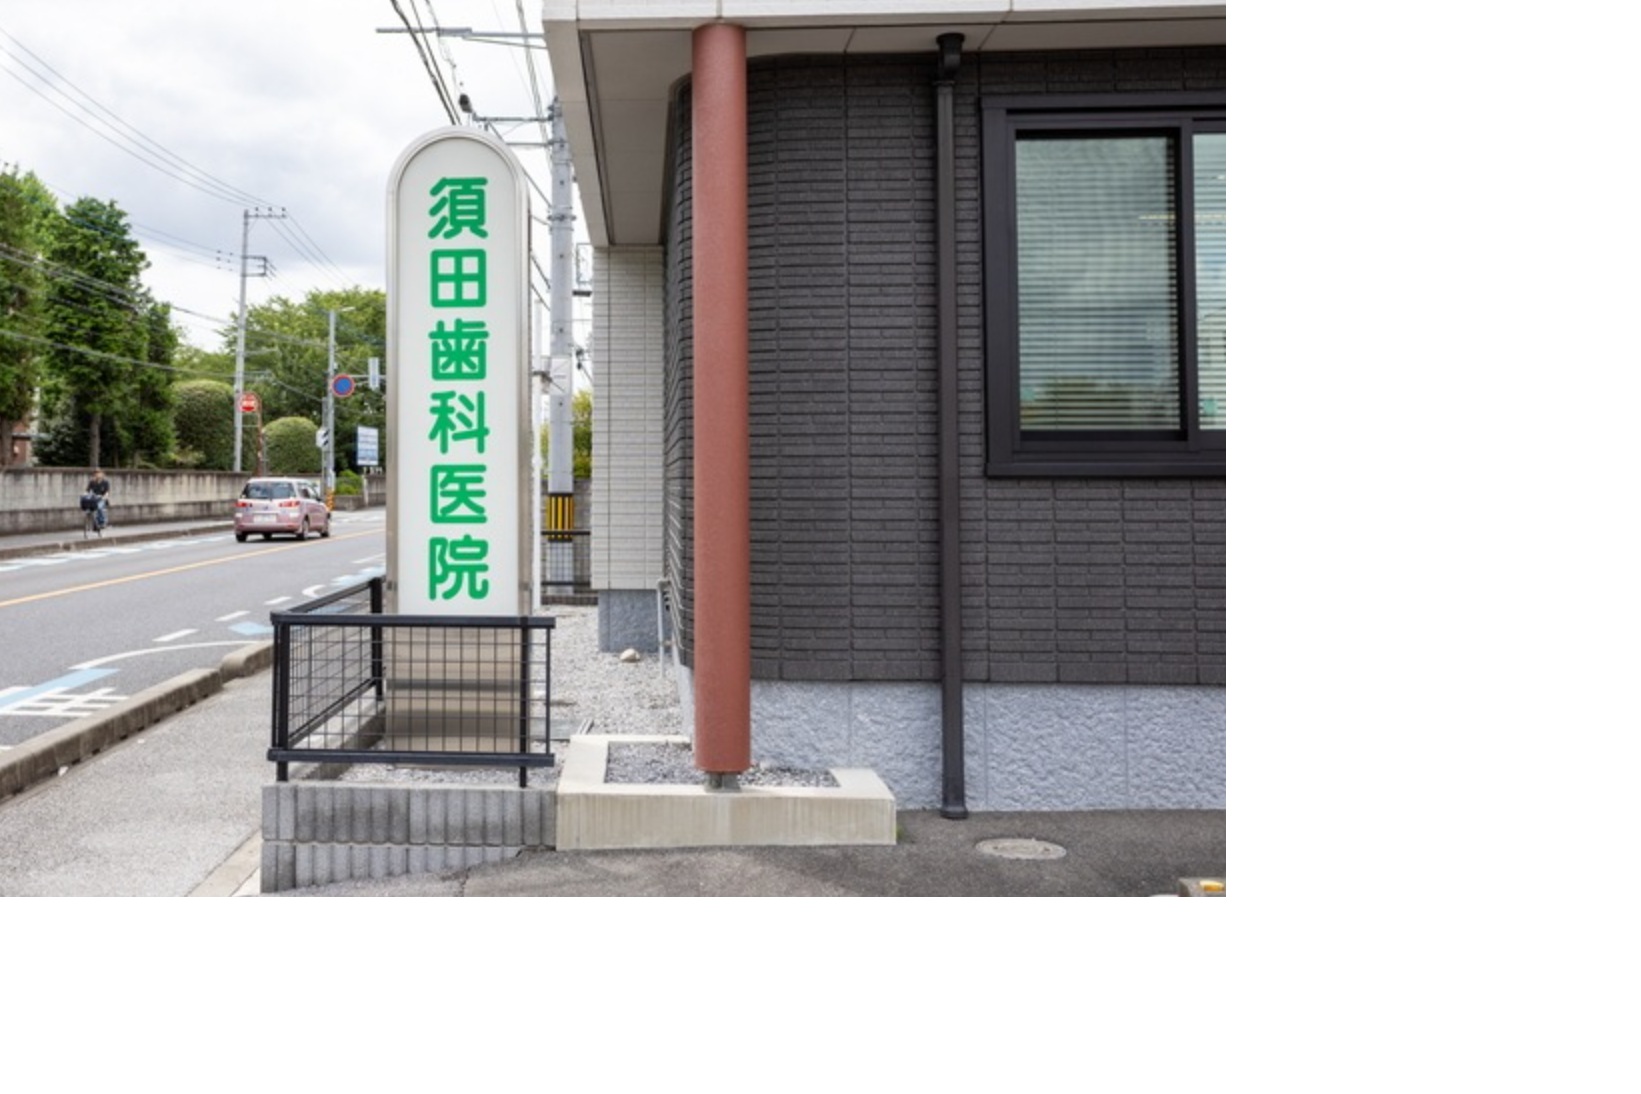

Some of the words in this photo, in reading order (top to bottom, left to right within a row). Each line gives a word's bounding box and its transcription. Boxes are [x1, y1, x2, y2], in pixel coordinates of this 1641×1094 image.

[428, 177, 490, 601] 須田歯科医院
